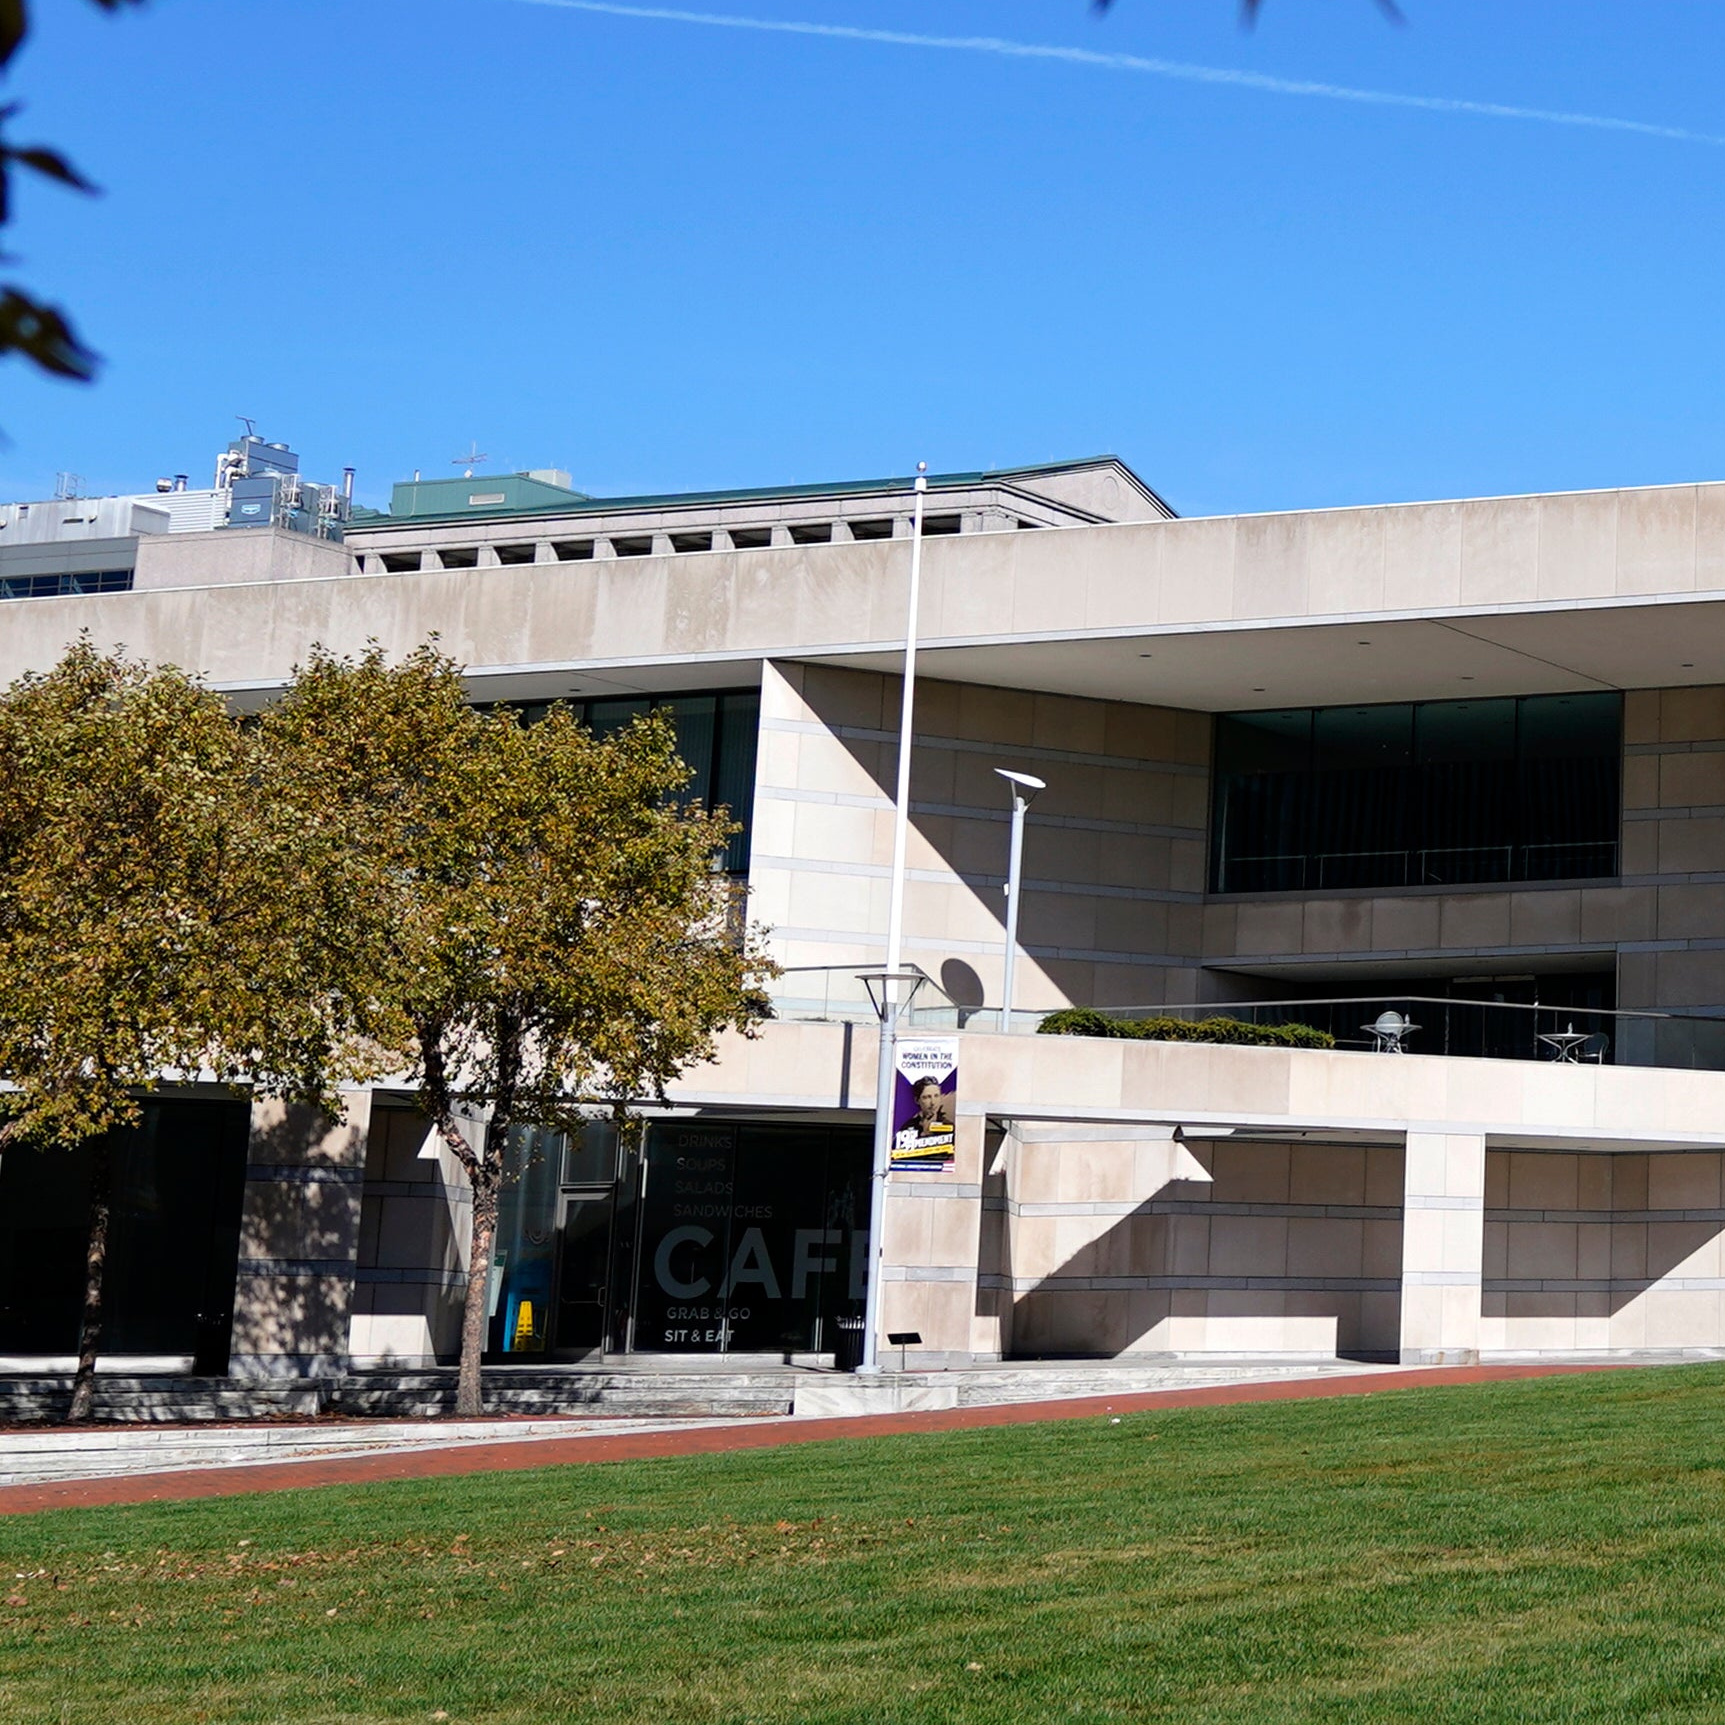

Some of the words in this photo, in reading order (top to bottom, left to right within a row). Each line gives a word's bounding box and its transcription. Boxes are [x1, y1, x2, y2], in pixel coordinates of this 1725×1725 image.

[901, 1061, 953, 1069] CONSTITUTION
[679, 1135, 733, 1149] DRINKS
[676, 1156, 727, 1172] SOUPS
[674, 1181, 735, 1195] SALADS
[672, 1203, 774, 1219] SANDWICHES
[666, 1306, 711, 1320] GRAB
[728, 1306, 751, 1320] GO
[663, 1329, 689, 1343] SIT
[690, 1329, 700, 1343] &
[704, 1329, 735, 1343] EAT
